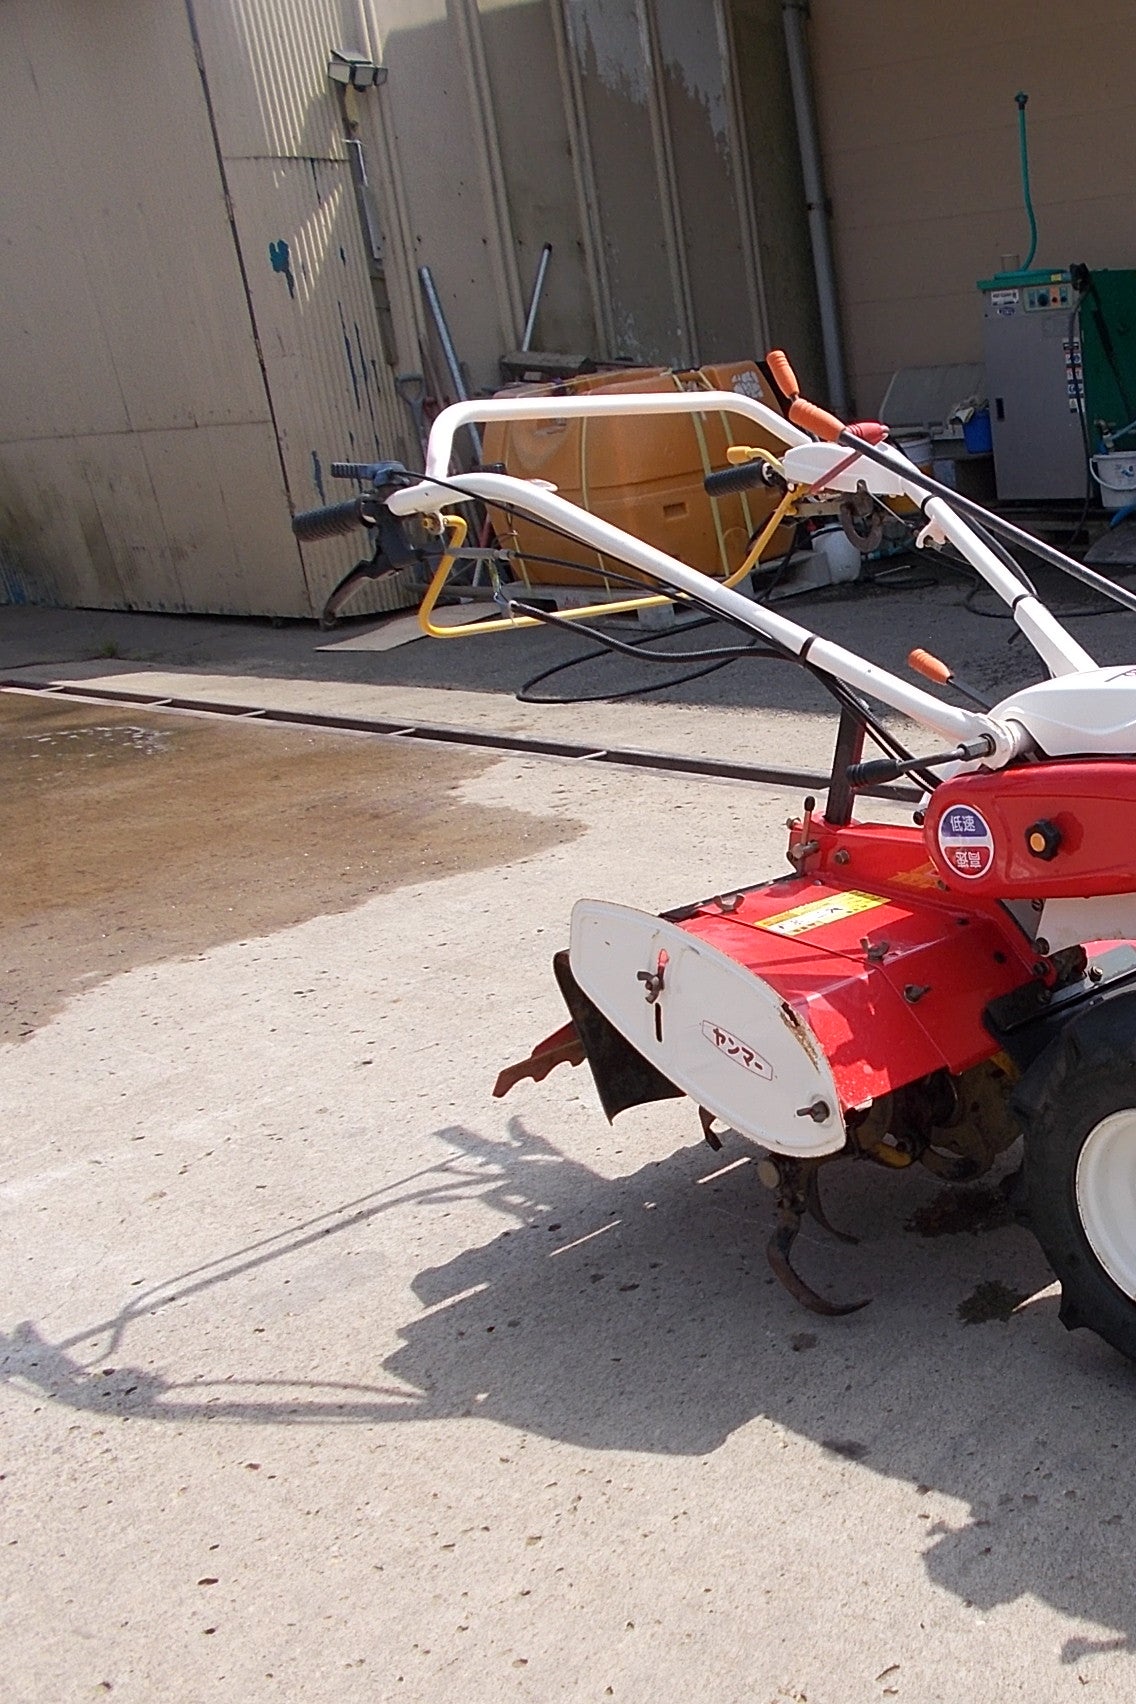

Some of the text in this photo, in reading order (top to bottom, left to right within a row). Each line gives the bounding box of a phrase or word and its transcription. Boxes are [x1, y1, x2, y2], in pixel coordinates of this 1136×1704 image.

[950, 815, 976, 832] 低速
[955, 851, 982, 868] 高速
[712, 1027, 763, 1071] ヤンマー
